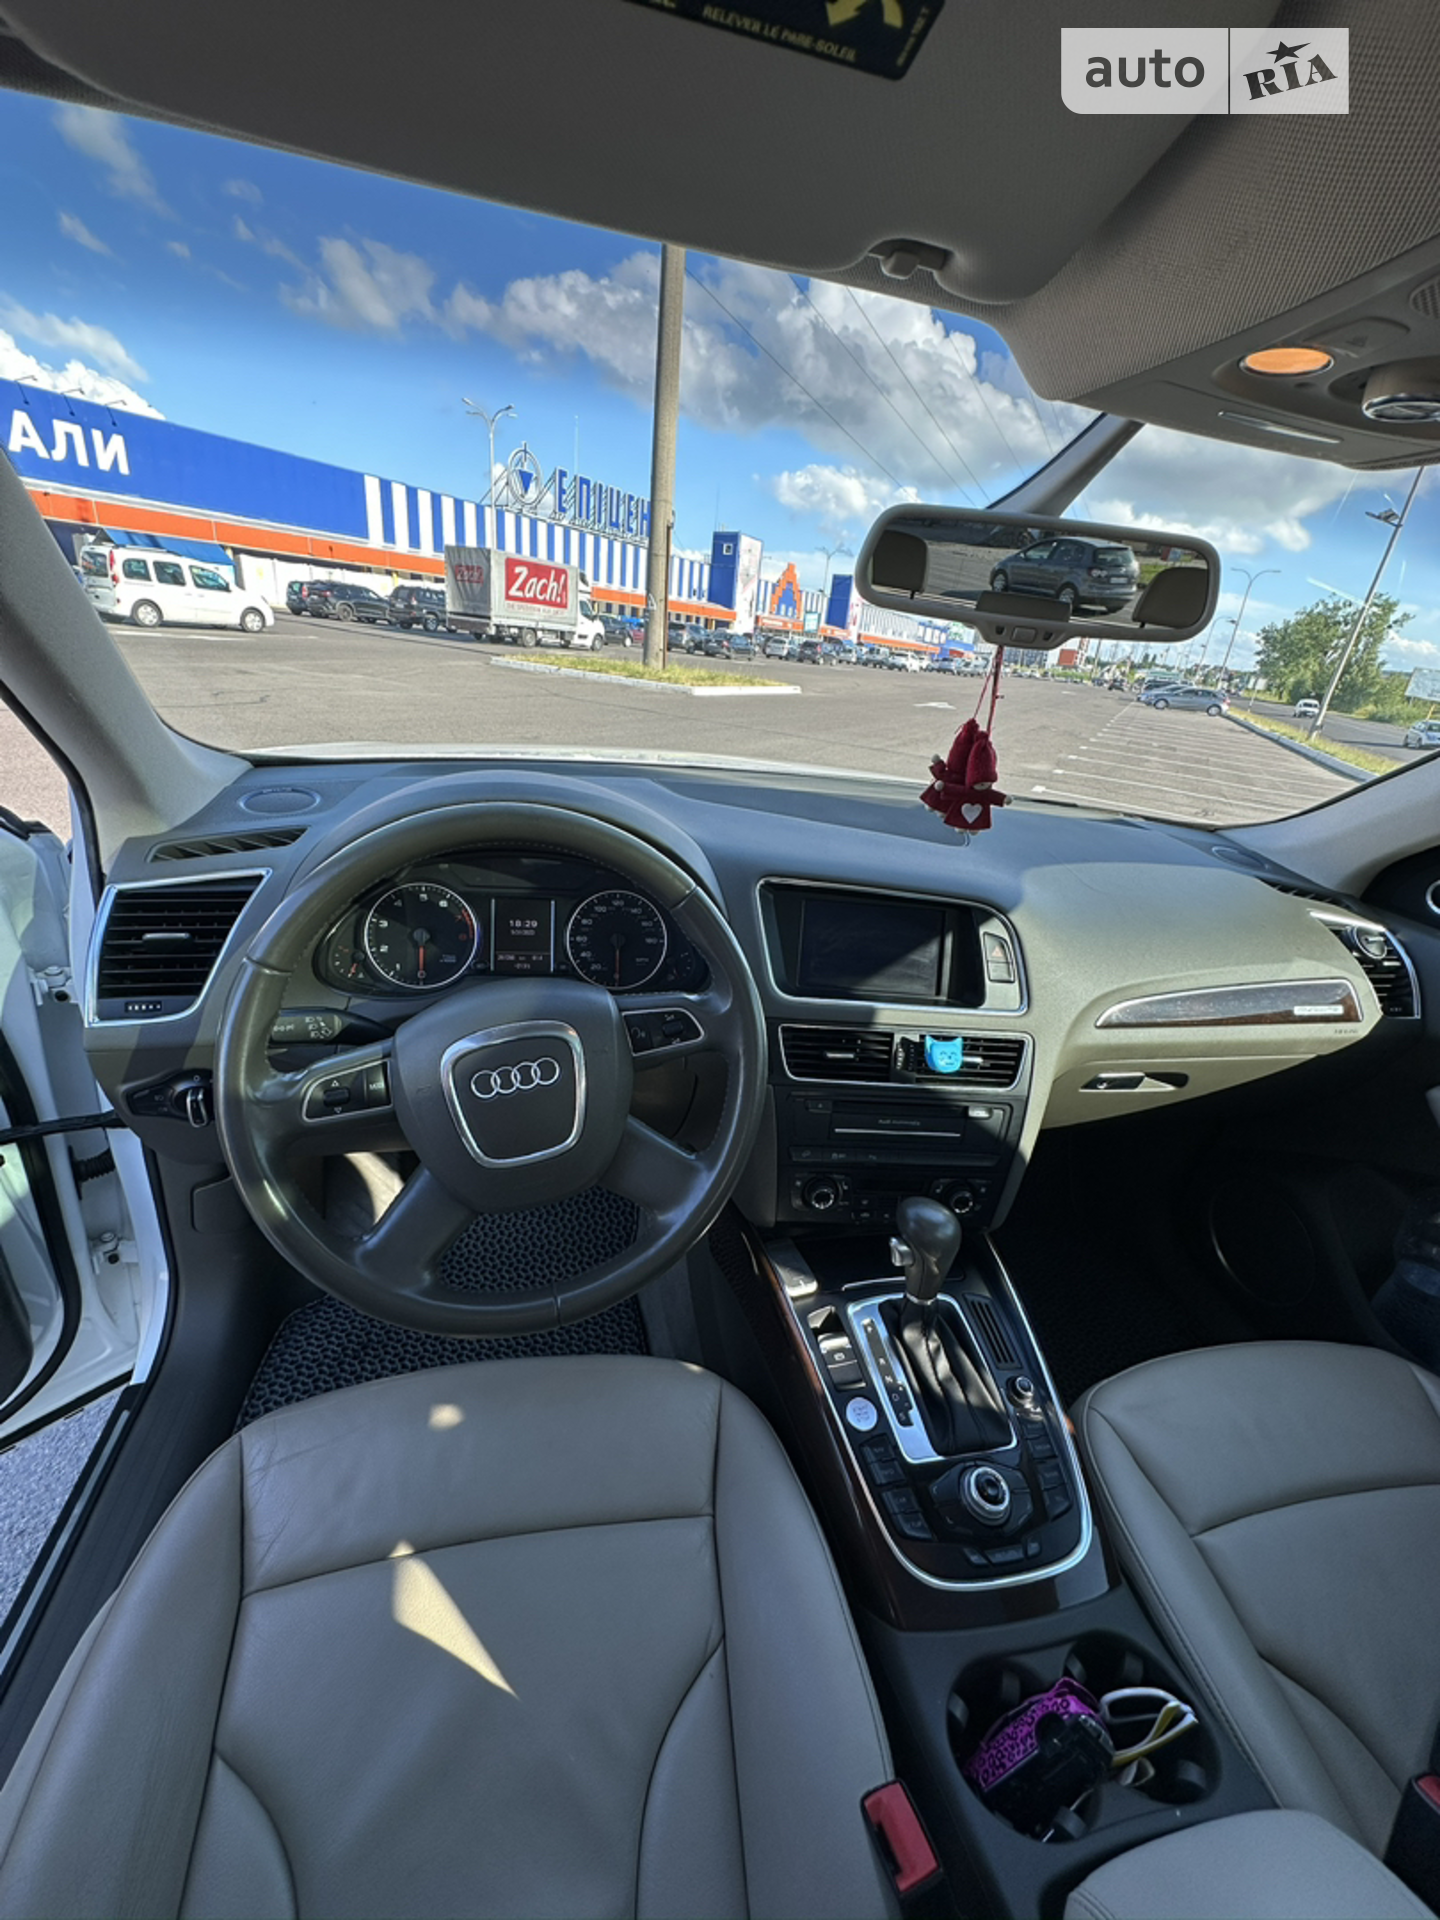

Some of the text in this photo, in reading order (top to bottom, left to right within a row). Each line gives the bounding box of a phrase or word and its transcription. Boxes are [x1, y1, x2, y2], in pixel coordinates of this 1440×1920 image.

[763, 23, 780, 39] LE
[781, 29, 856, 62] PARE-SOLEIL
[9, 409, 130, 475] АЛИ
[508, 565, 566, 604] Zach!
